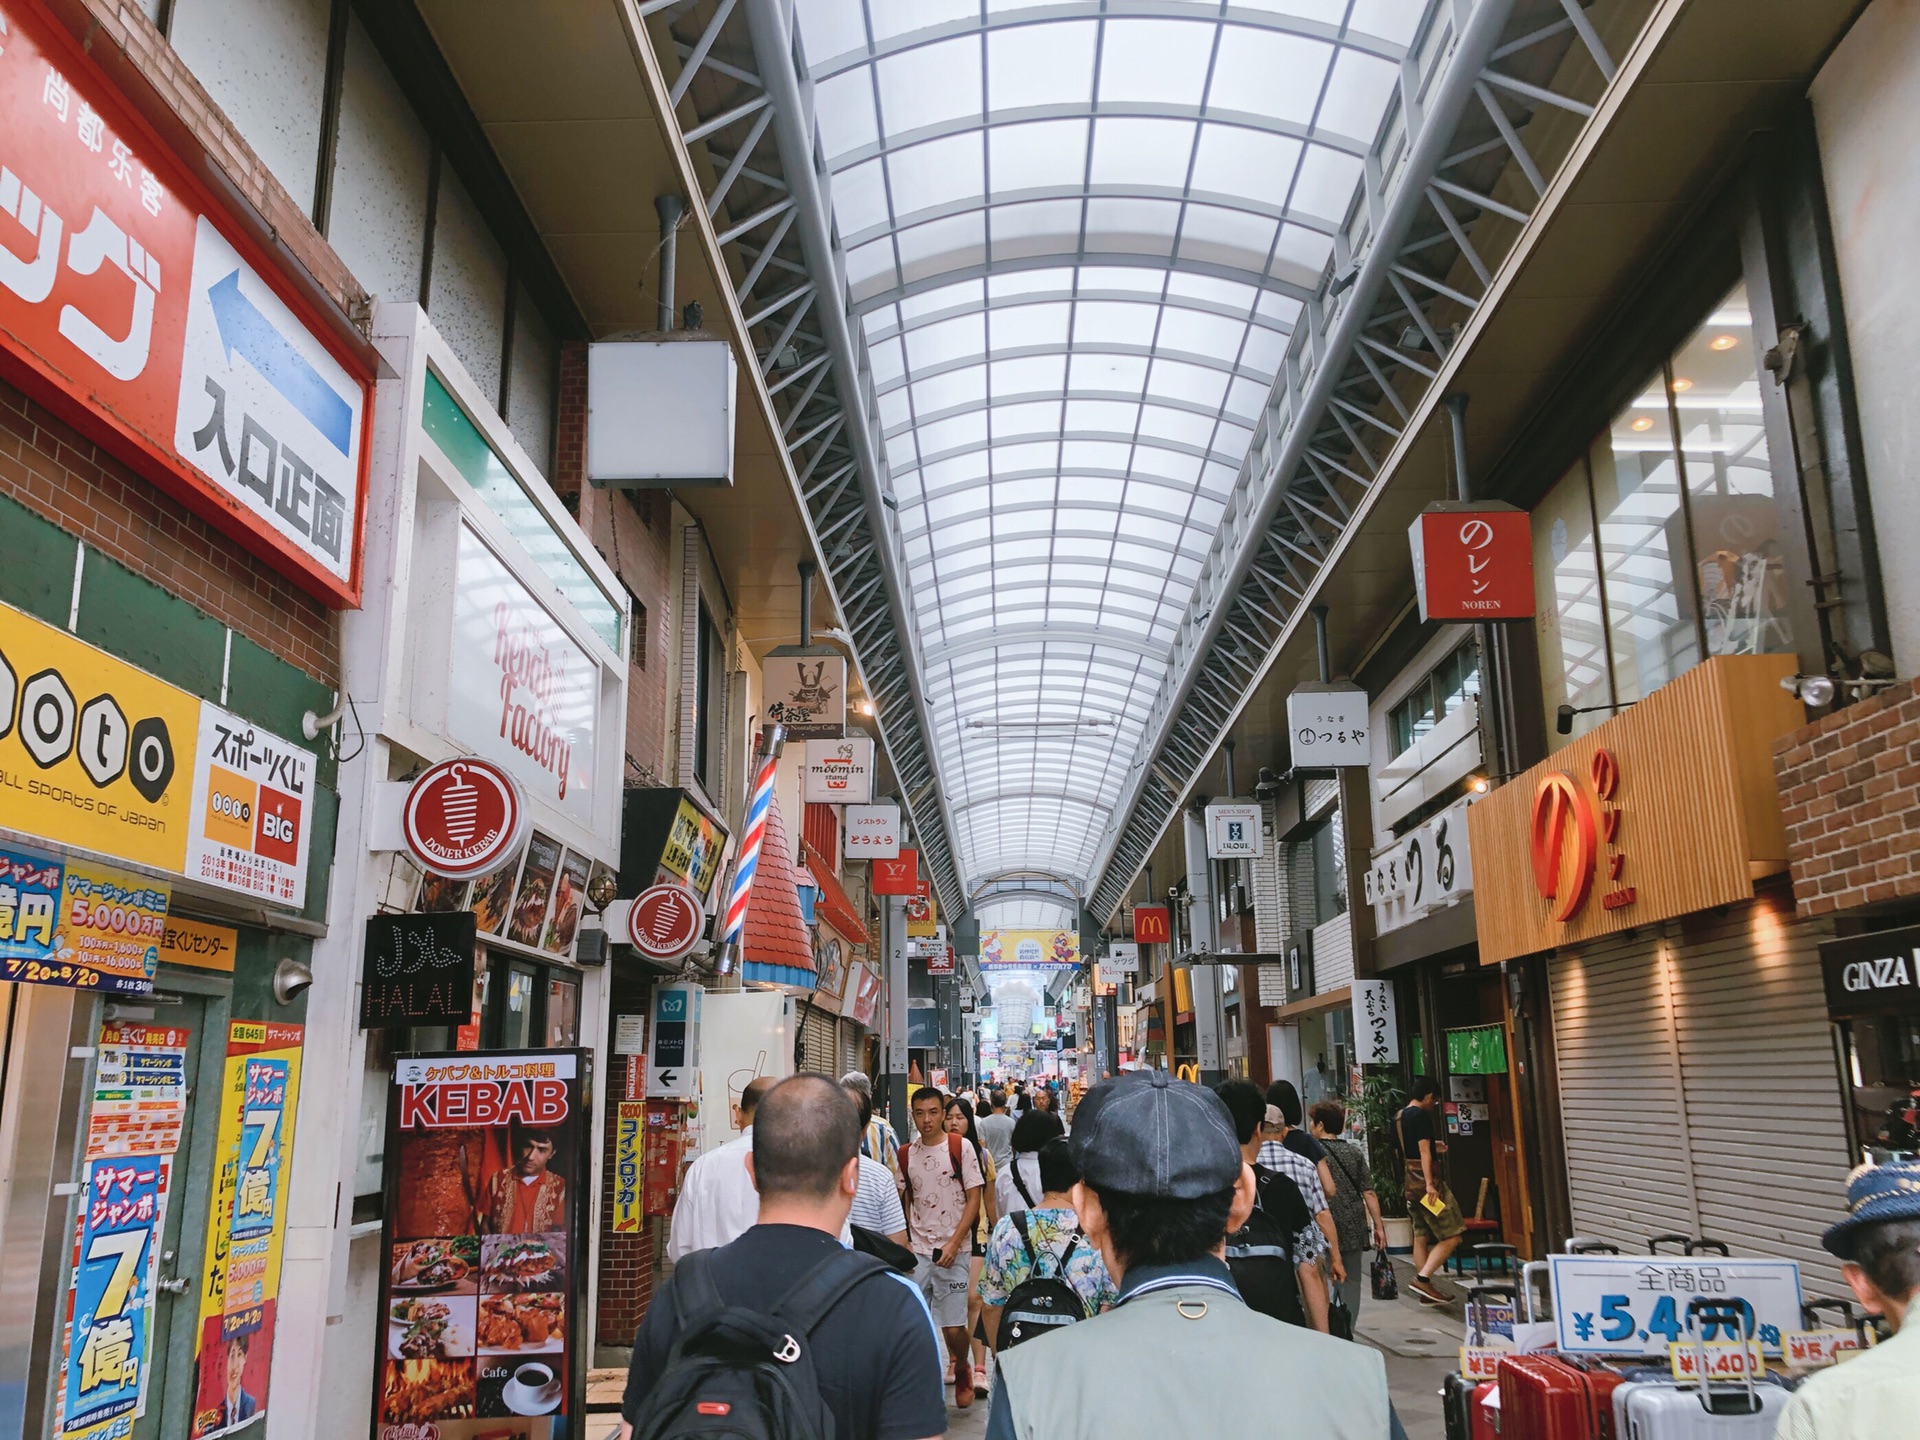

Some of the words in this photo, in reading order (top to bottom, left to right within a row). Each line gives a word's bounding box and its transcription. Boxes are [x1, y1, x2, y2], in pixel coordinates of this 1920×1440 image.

[42, 66, 164, 217] 尚都乐客
[193, 375, 346, 564] 入口正面
[1460, 520, 1493, 594] のレン
[1462, 600, 1501, 609] NOREN
[494, 601, 552, 704] Kebab
[768, 702, 812, 723] 侍茶屋
[500, 673, 570, 800] Factory
[1318, 730, 1364, 745] つるや
[212, 724, 305, 794] スポーツくじ
[97, 801, 117, 816] OF
[212, 791, 251, 823] toto
[262, 812, 294, 843] BIG
[850, 835, 893, 845] とうよう
[425, 837, 462, 859] DONER
[464, 829, 498, 857] KEBAB
[1531, 770, 1597, 922] の
[67, 874, 167, 914] サマージャンボミニ
[1367, 861, 1396, 900] うなぎ
[72, 898, 164, 937] 5,000万円
[638, 927, 657, 949] DONER
[657, 937, 681, 950] KEBAB
[1201, 942, 1206, 951] 2
[895, 950, 900, 959] 2
[1843, 956, 1911, 992] GINZA
[367, 983, 462, 1017] HALAL
[1365, 990, 1375, 1017] 天ぷら
[1379, 983, 1390, 1013] うなぎ
[268, 1029, 301, 1041] サマージャンボ
[1370, 1017, 1389, 1061] つるや
[141, 1058, 172, 1068] サマージャンボ
[249, 1064, 285, 1086] サマー
[425, 1063, 555, 1081] ケバブ&トルコ料理
[629, 1056, 637, 1099] NINJABAR
[136, 1076, 175, 1086] サマージャンボミニ
[247, 1085, 283, 1107] ジャンボ
[401, 1080, 569, 1128] KEBAB
[95, 1166, 156, 1199] サマー
[616, 1118, 638, 1220] コインロッカー
[90, 1194, 155, 1232] ジャンボ
[1636, 1265, 1726, 1293] 全商品
[482, 1367, 507, 1378] Cafe
